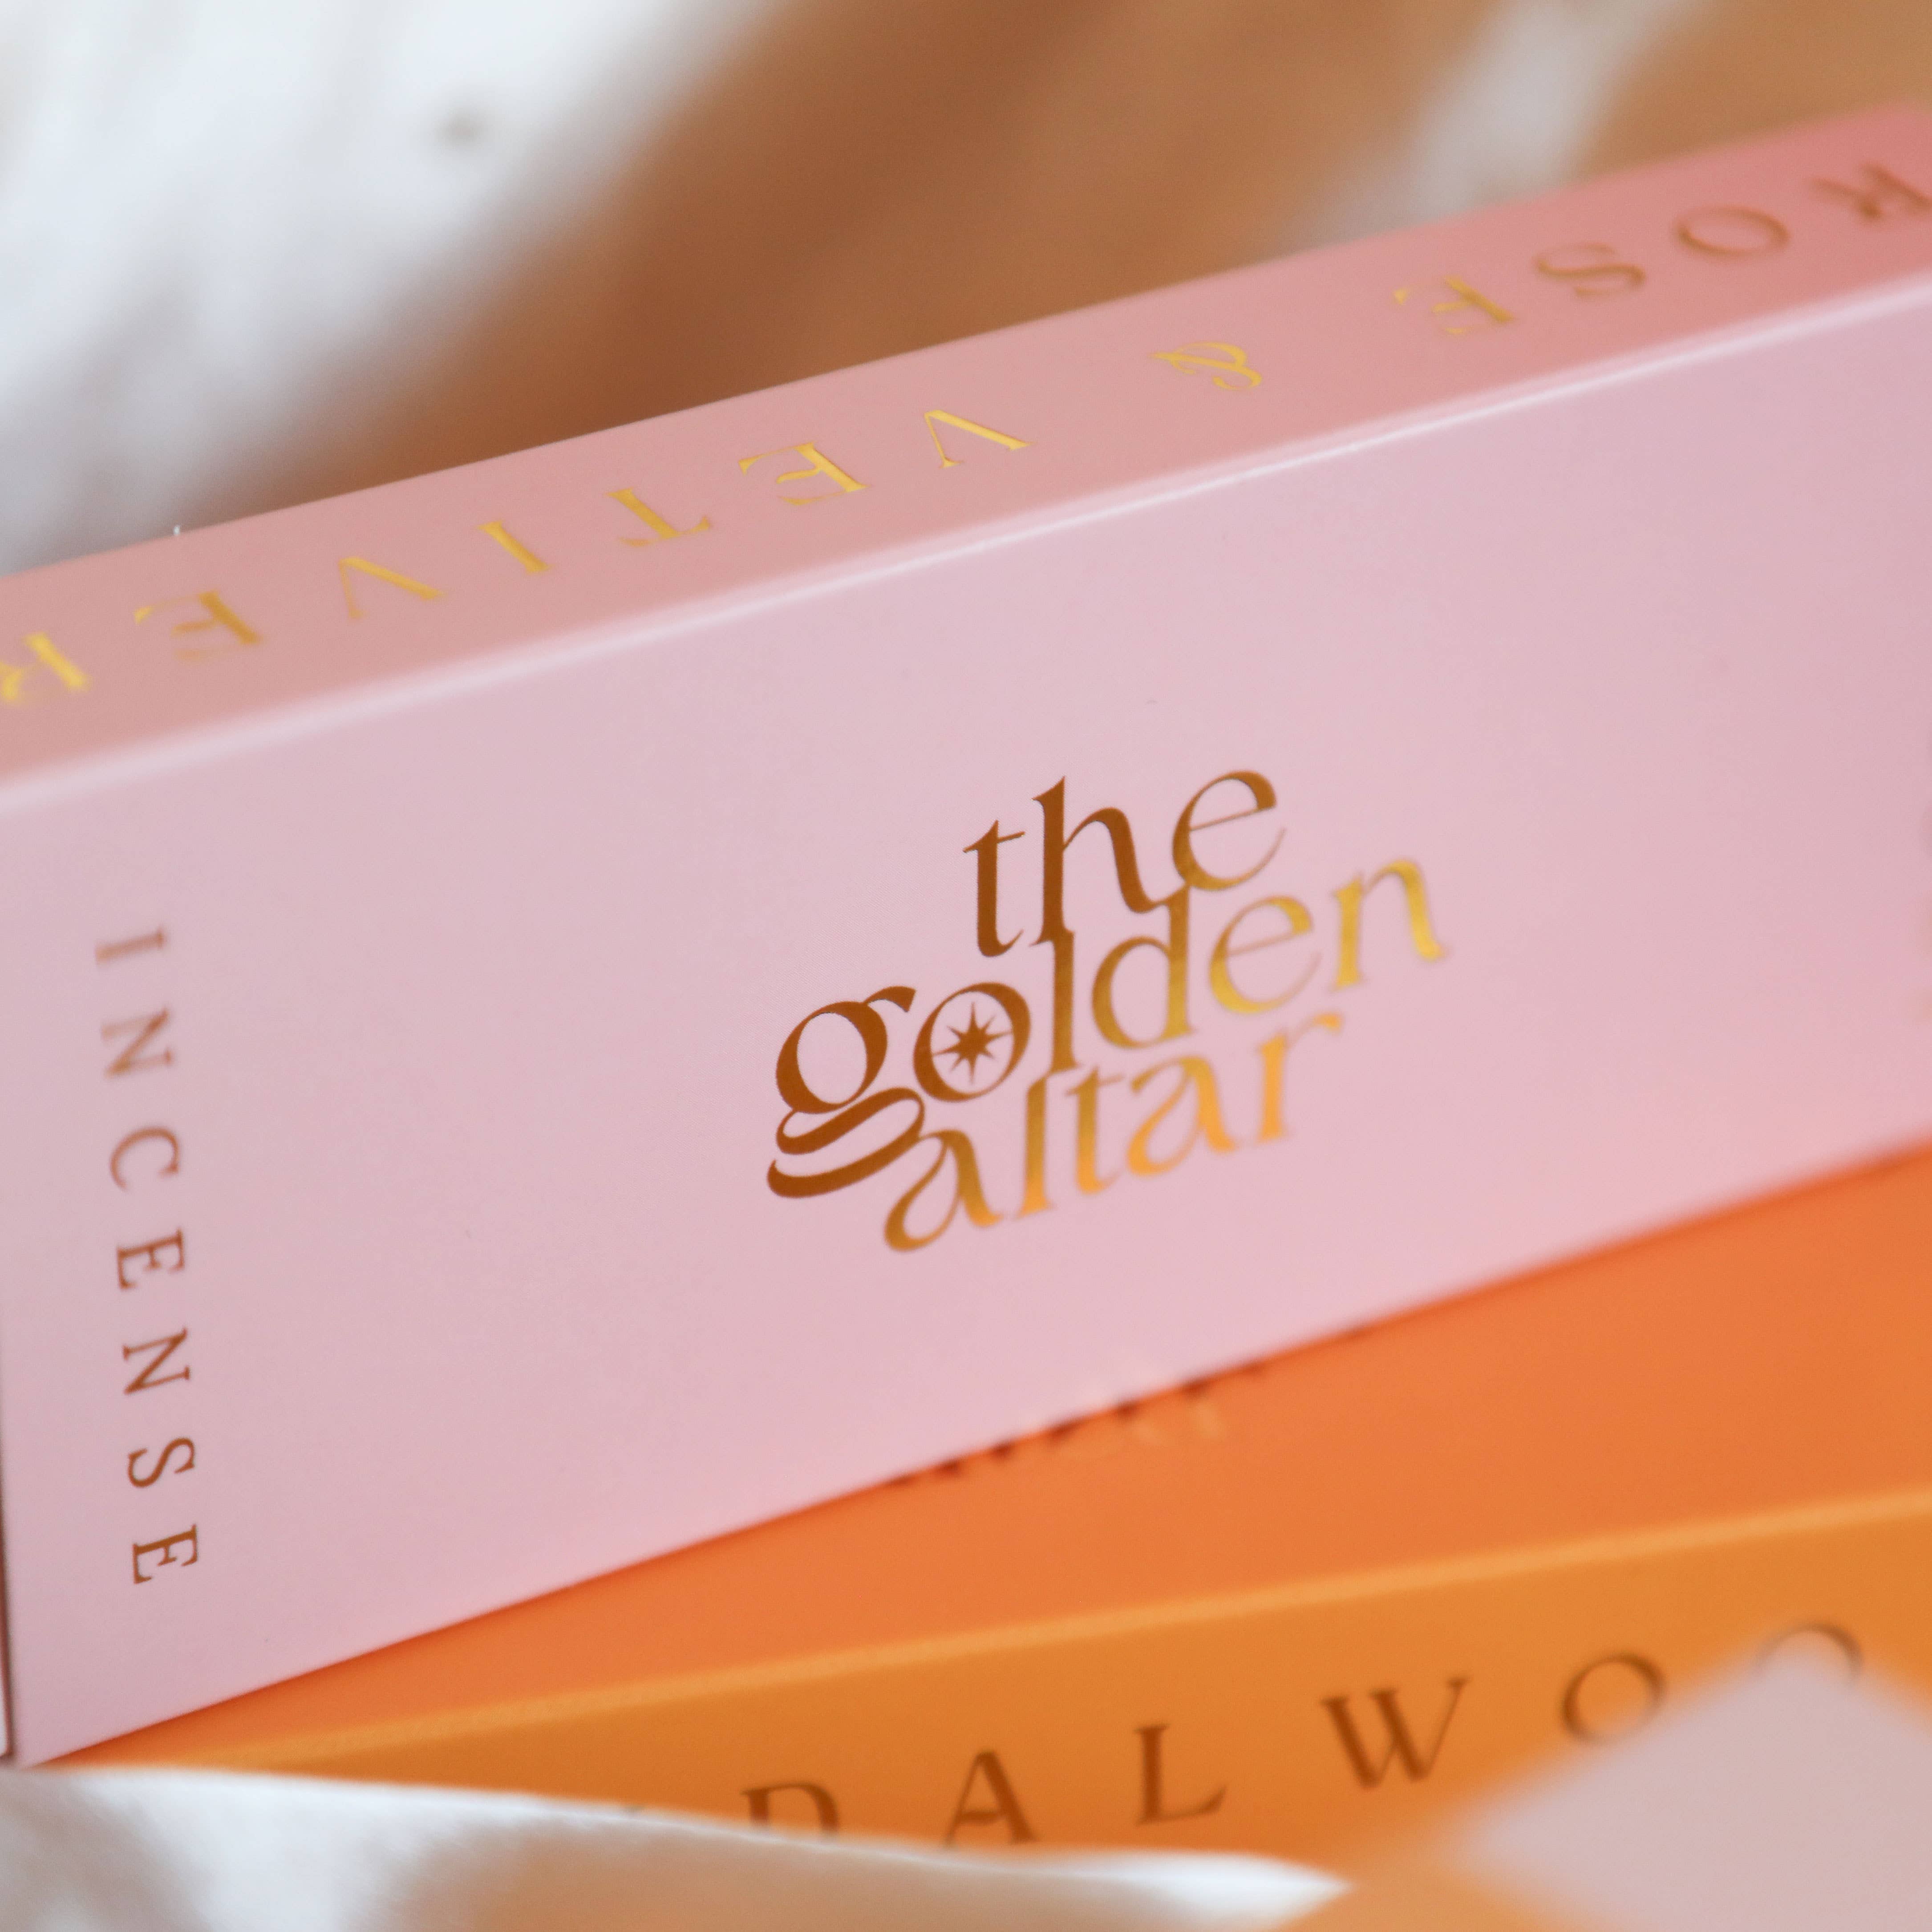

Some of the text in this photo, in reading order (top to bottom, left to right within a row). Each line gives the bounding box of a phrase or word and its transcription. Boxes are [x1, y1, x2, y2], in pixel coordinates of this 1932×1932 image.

[0, 161, 1932, 703] ROSE & VETIVER
[766, 858, 1449, 1198] golden
[962, 770, 1286, 957] the
[95, 926, 199, 1585] INCENSE
[884, 1012, 1344, 1252] altar
